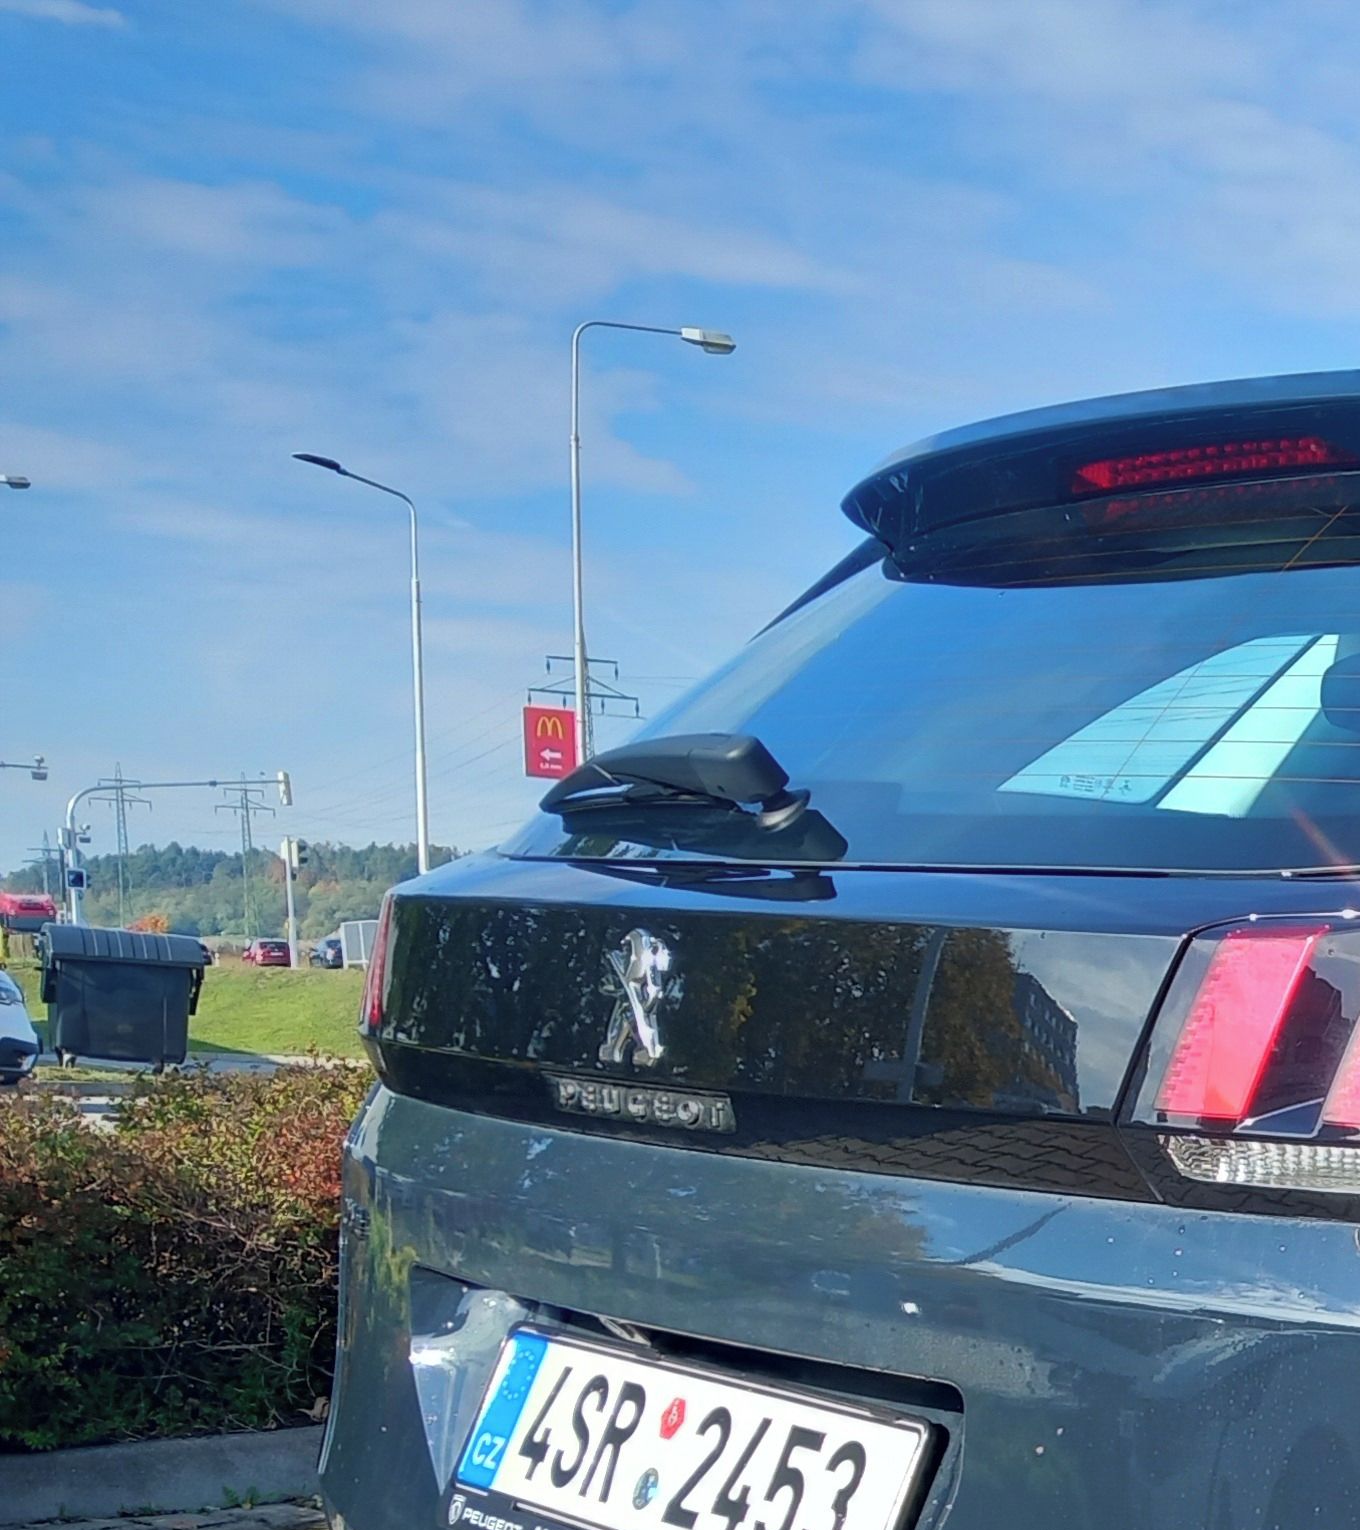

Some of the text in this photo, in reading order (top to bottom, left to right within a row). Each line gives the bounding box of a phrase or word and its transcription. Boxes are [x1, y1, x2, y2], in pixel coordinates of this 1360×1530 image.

[558, 1080, 727, 1129] PEUGEOT
[471, 1431, 506, 1470] CZ
[517, 1365, 647, 1504] 4SR
